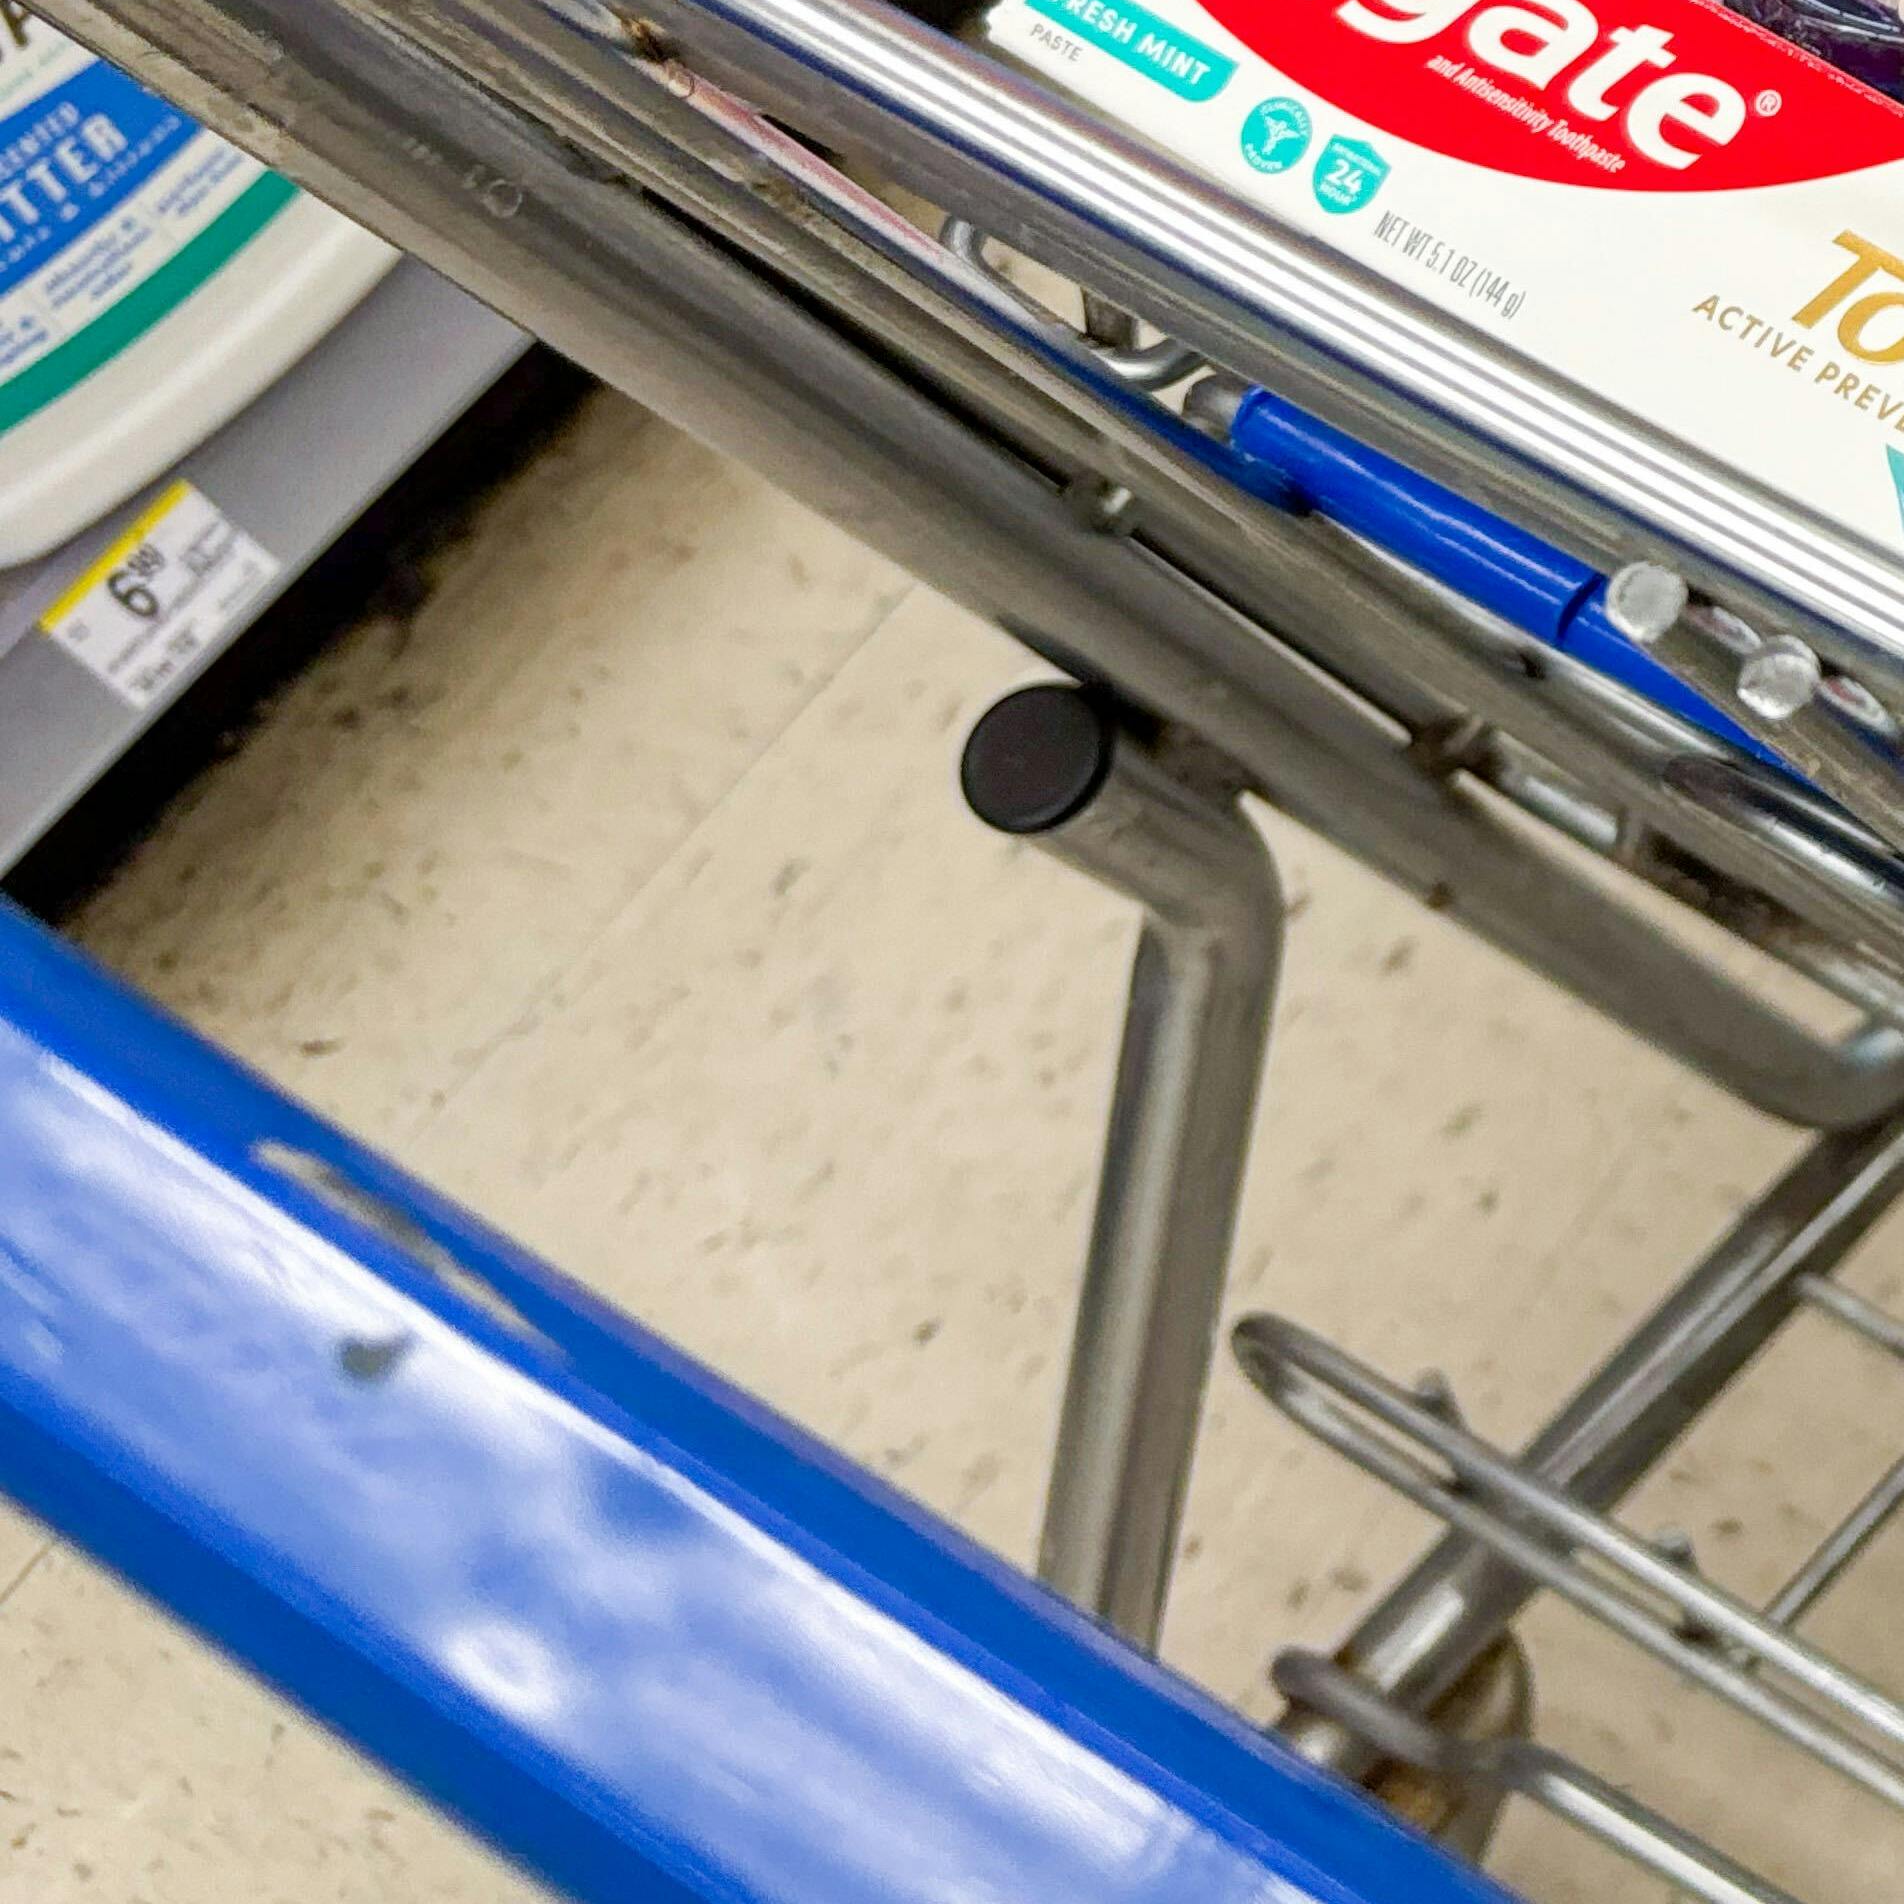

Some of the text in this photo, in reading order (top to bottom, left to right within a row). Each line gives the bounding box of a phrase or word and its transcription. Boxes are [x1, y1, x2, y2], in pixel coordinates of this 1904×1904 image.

[1030, 24, 1083, 64] PASTE
[1137, 30, 1211, 89] MINT
[1427, 54, 1626, 175] and Antisensitivity Toothpaste
[1693, 295, 1815, 374] ACTIVE
